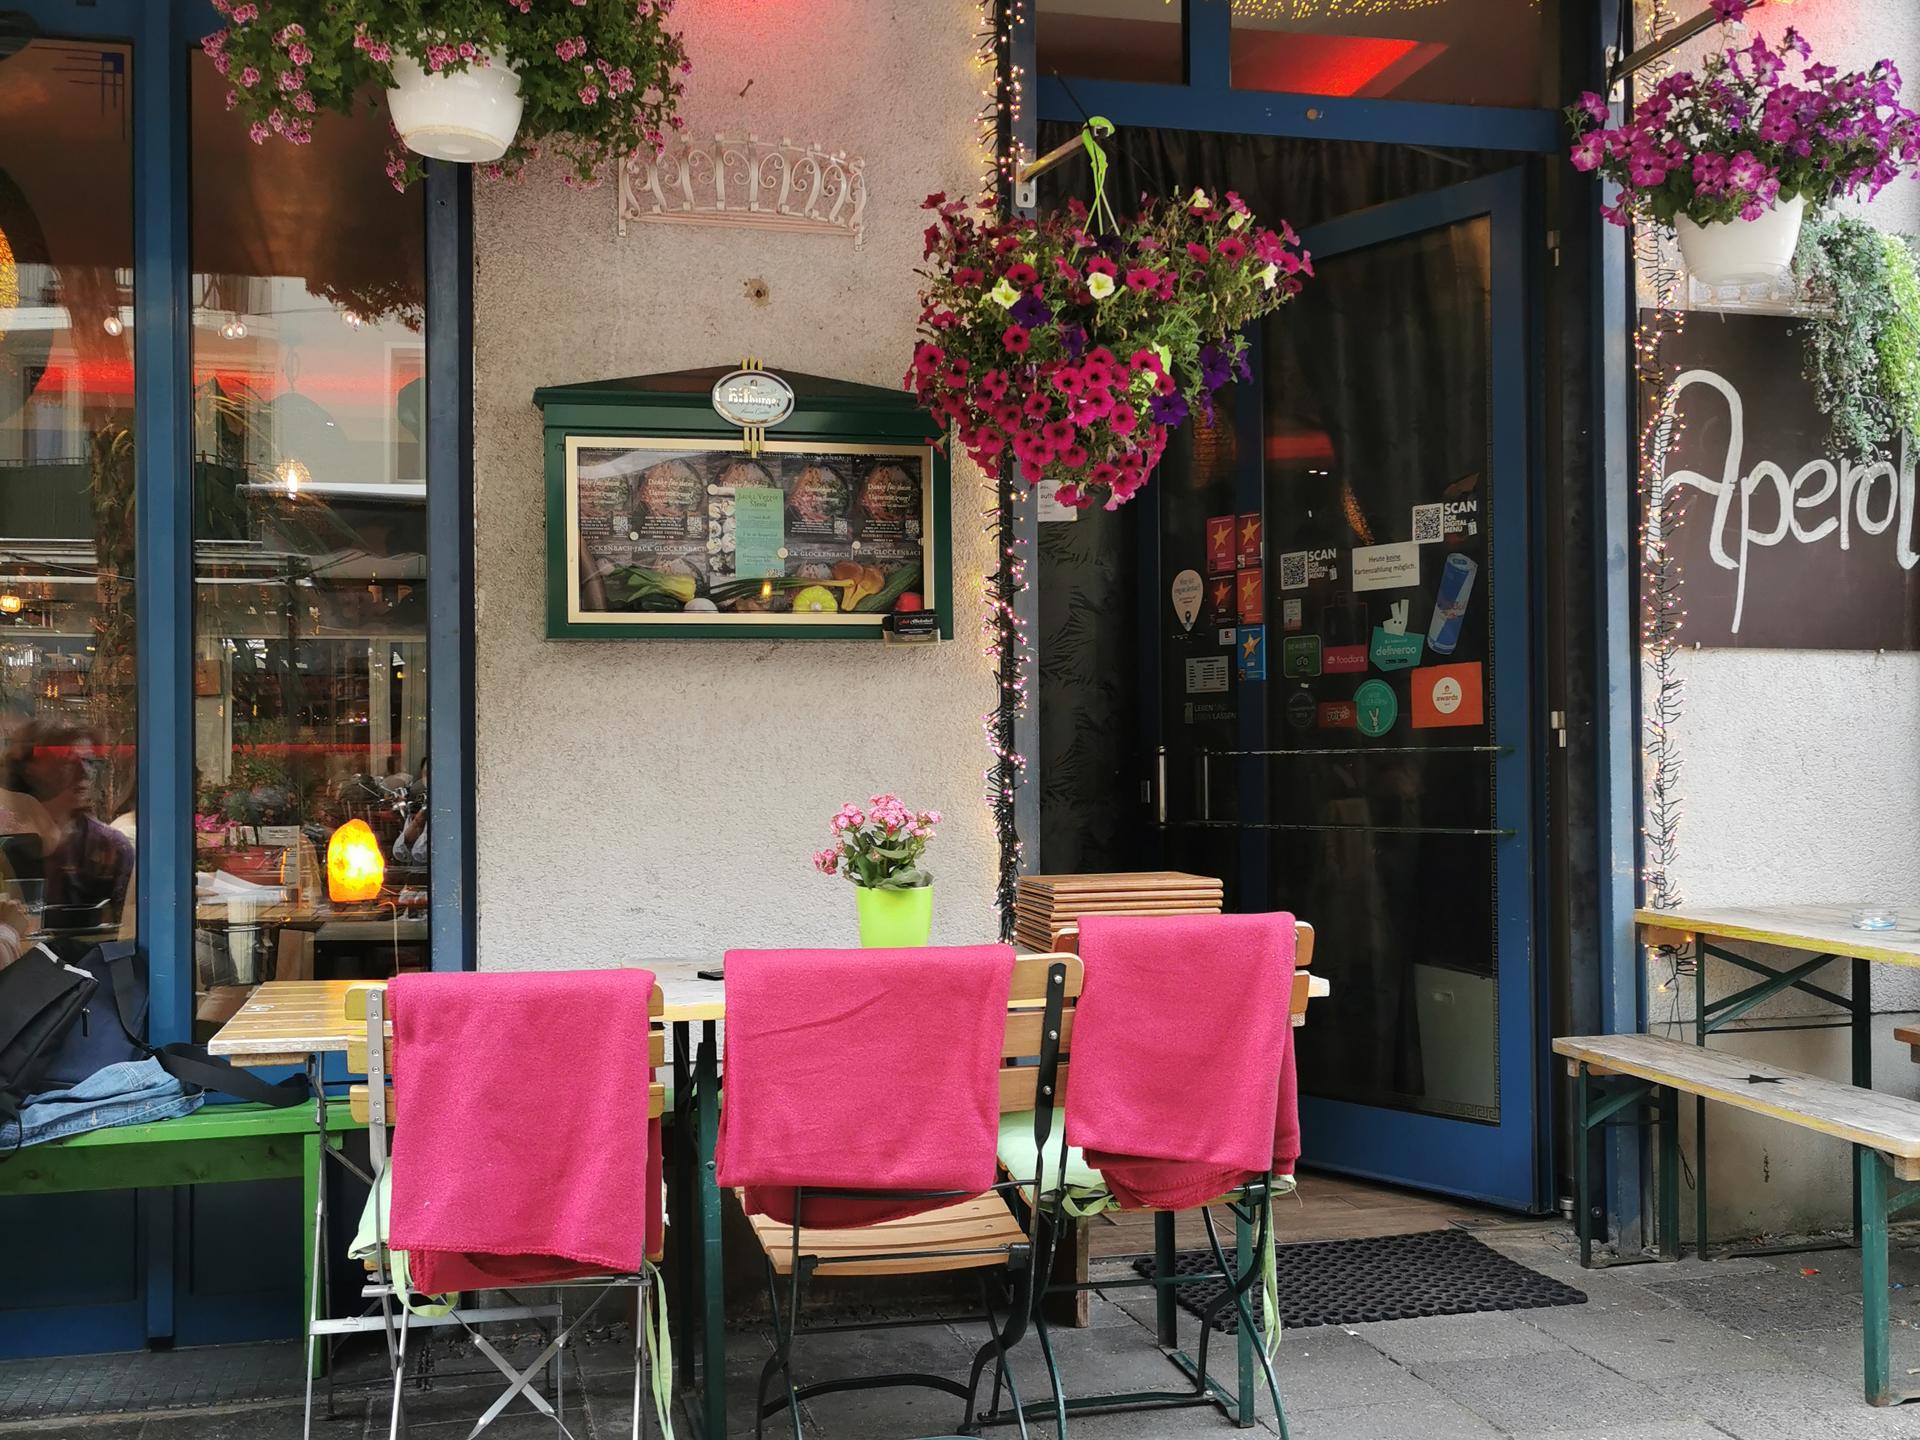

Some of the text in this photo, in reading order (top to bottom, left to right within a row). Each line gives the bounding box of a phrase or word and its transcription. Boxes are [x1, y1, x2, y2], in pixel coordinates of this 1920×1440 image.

[1645, 369, 1919, 633] Aperol
[1445, 500, 1477, 514] SCAN
[1308, 548, 1336, 561] SCAN
[1309, 565, 1328, 573] DIGITAL
[1376, 645, 1417, 656] deliveroo
[1336, 655, 1365, 664] foodora
[1436, 694, 1458, 702] awards
